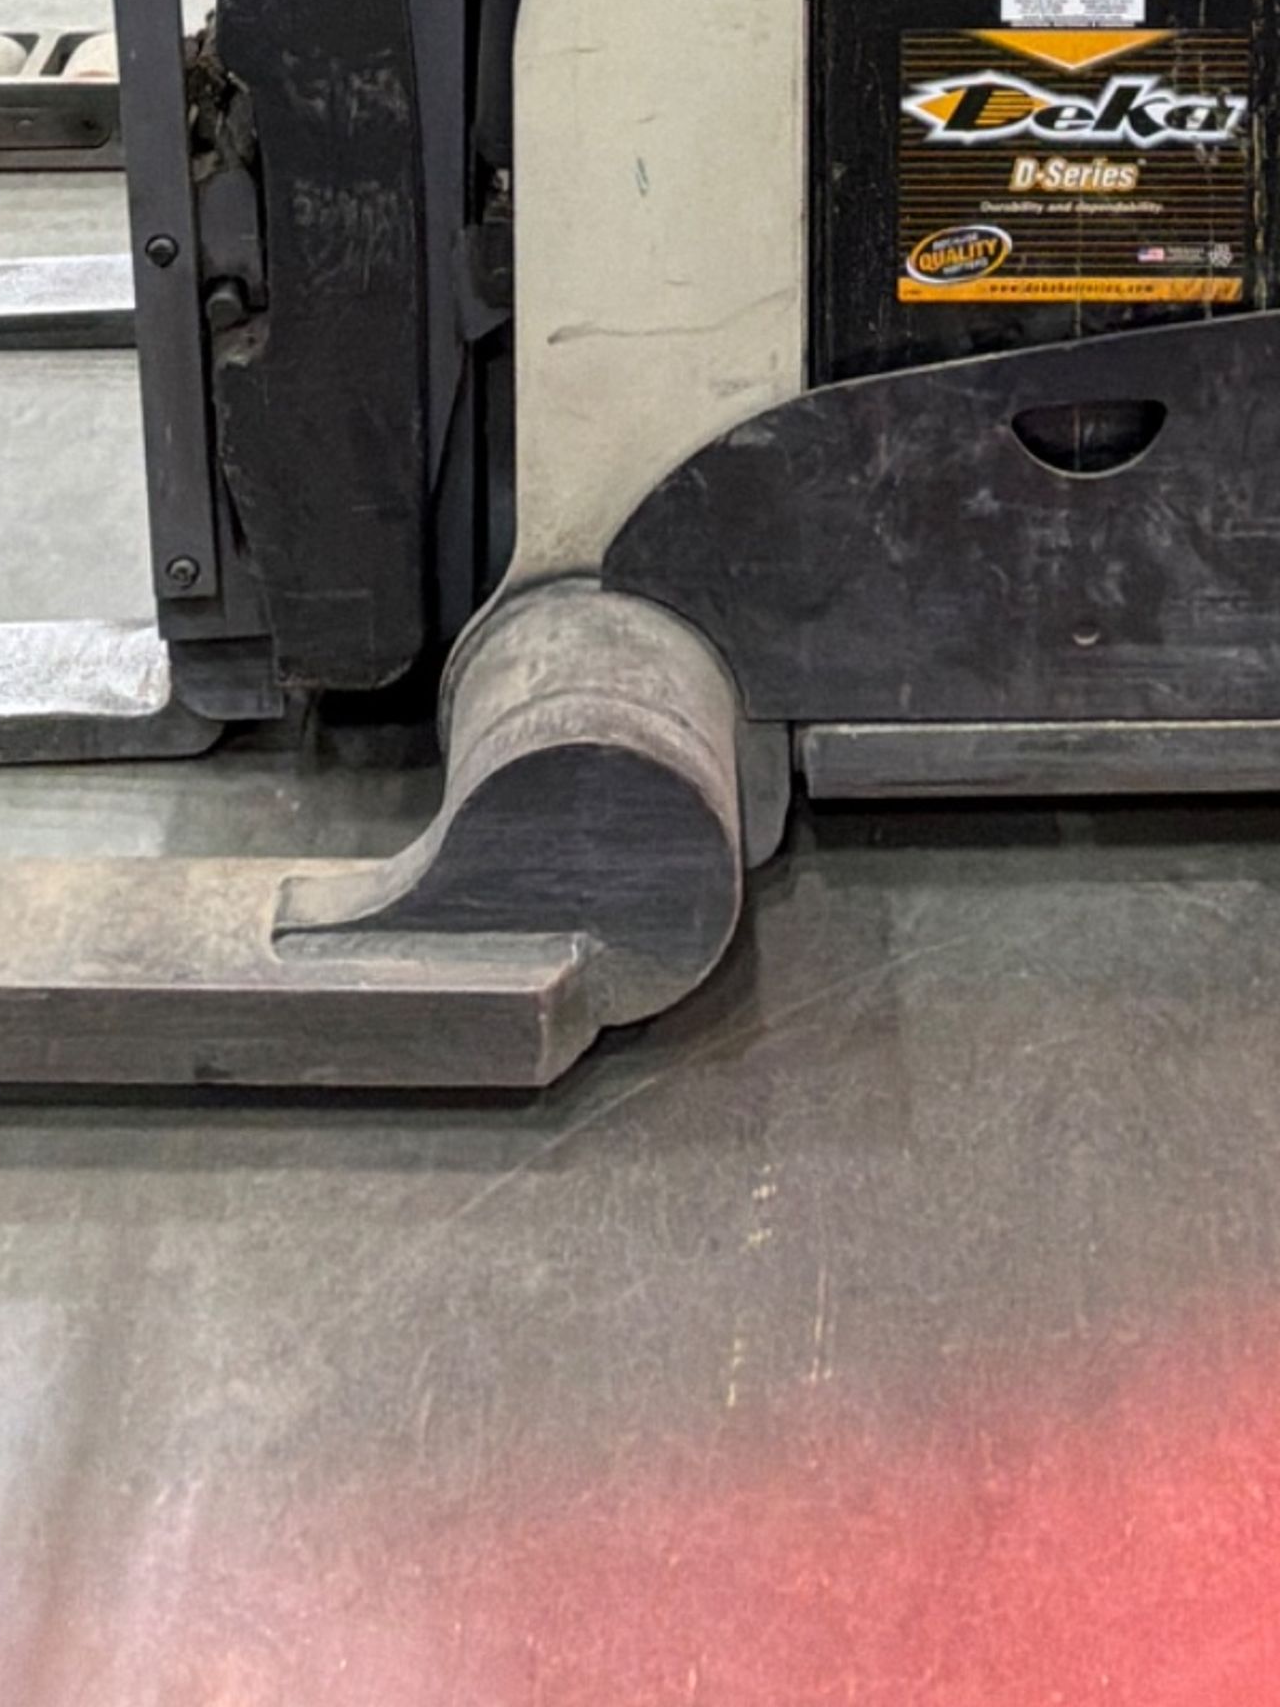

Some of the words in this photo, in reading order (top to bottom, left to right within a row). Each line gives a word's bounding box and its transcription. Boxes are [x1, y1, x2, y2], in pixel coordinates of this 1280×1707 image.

[910, 75, 1246, 143] Deka
[1011, 158, 1138, 190] D-Series
[980, 199, 1044, 215] Durability
[1046, 200, 1072, 213] and
[919, 238, 998, 272] QUALITY
